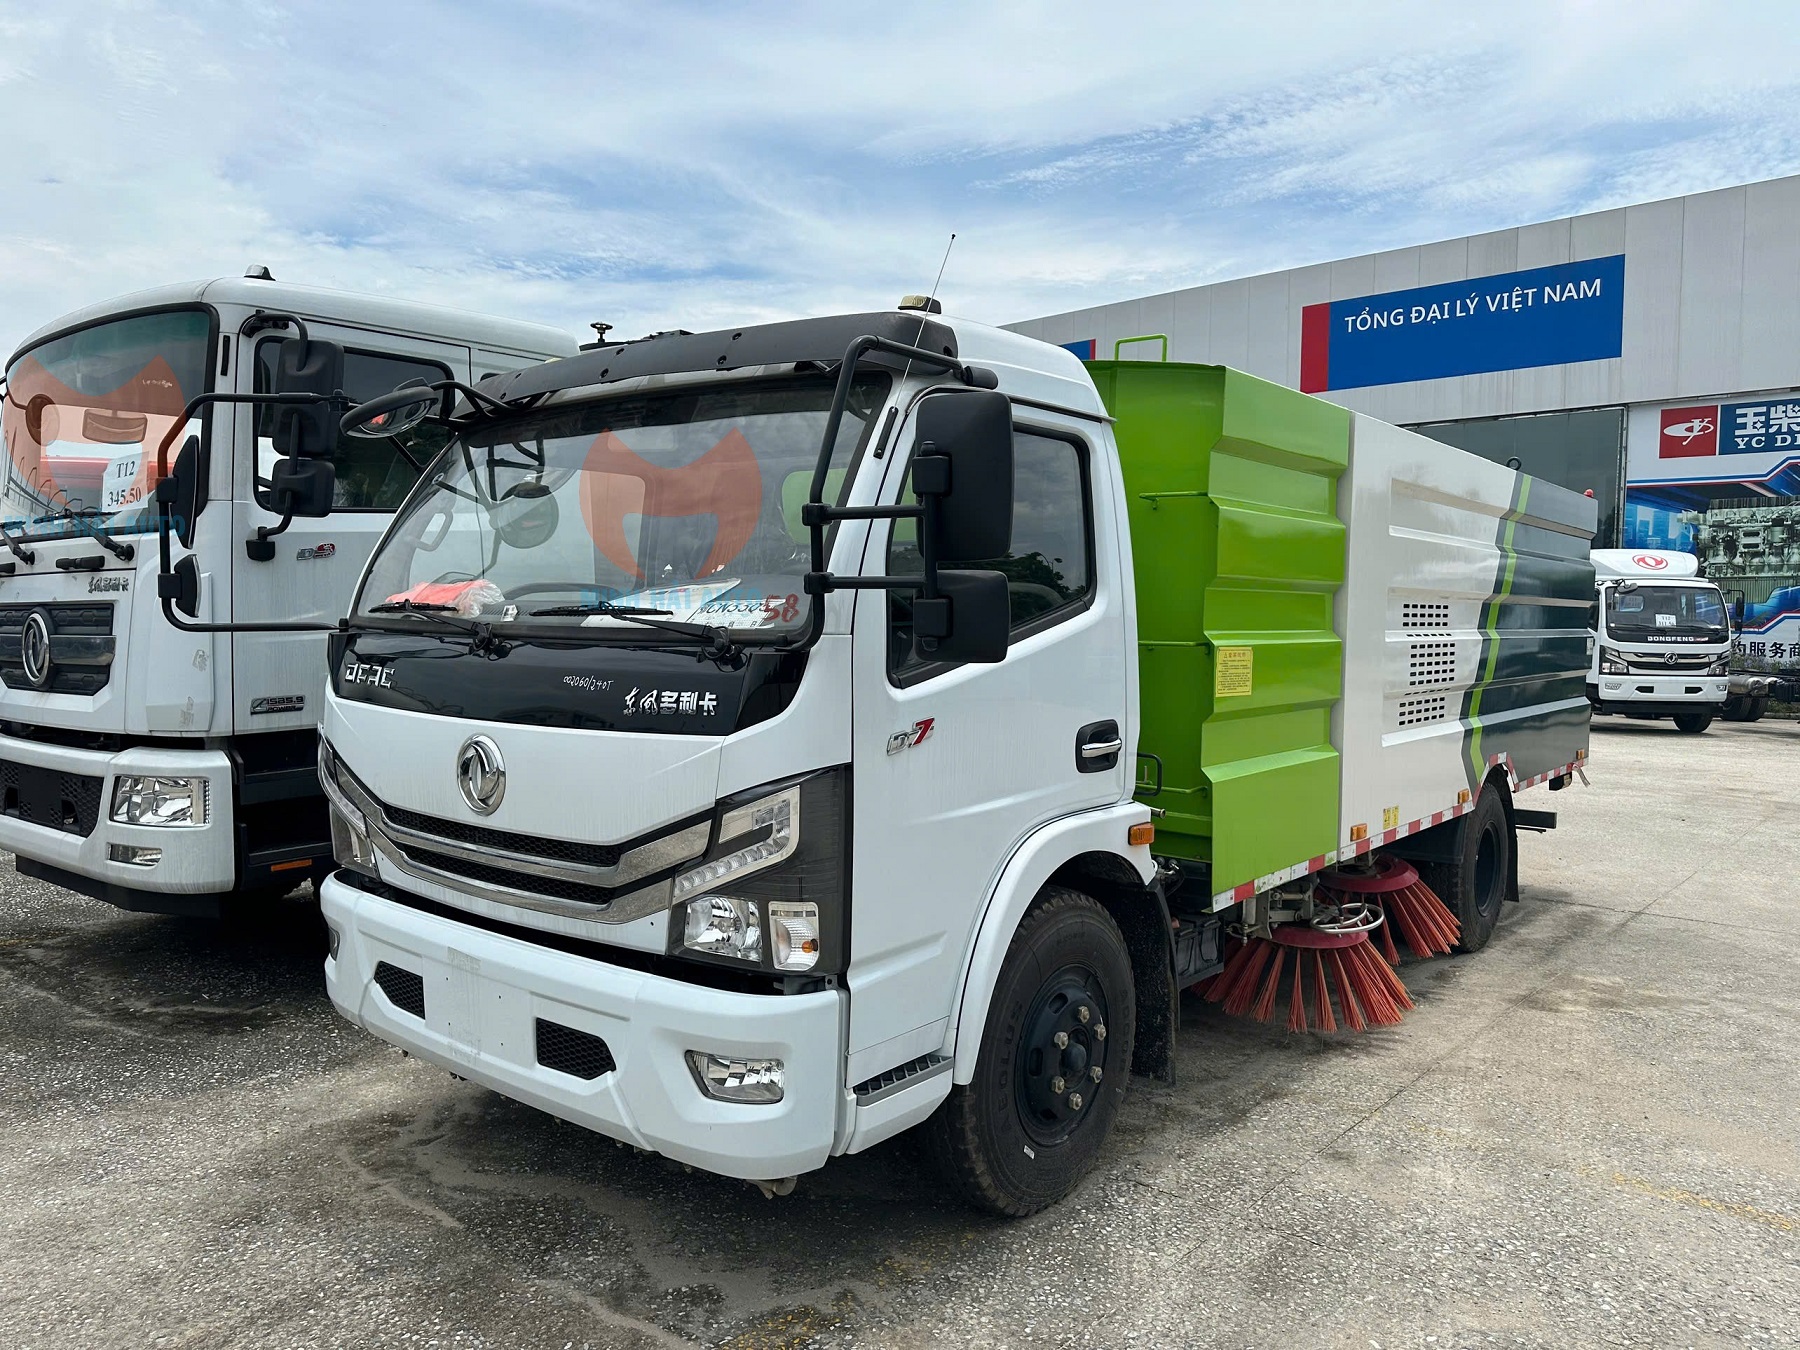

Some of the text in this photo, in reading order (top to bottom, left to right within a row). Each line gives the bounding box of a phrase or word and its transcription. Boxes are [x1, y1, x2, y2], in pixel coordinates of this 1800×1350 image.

[1344, 278, 1602, 333] TỔNG ĐẠI LÝ VIỆT NAM
[1734, 403, 1800, 436] 玉柴
[1735, 436, 1765, 449] YC
[116, 460, 136, 479] T12
[107, 486, 142, 507] 345.50
